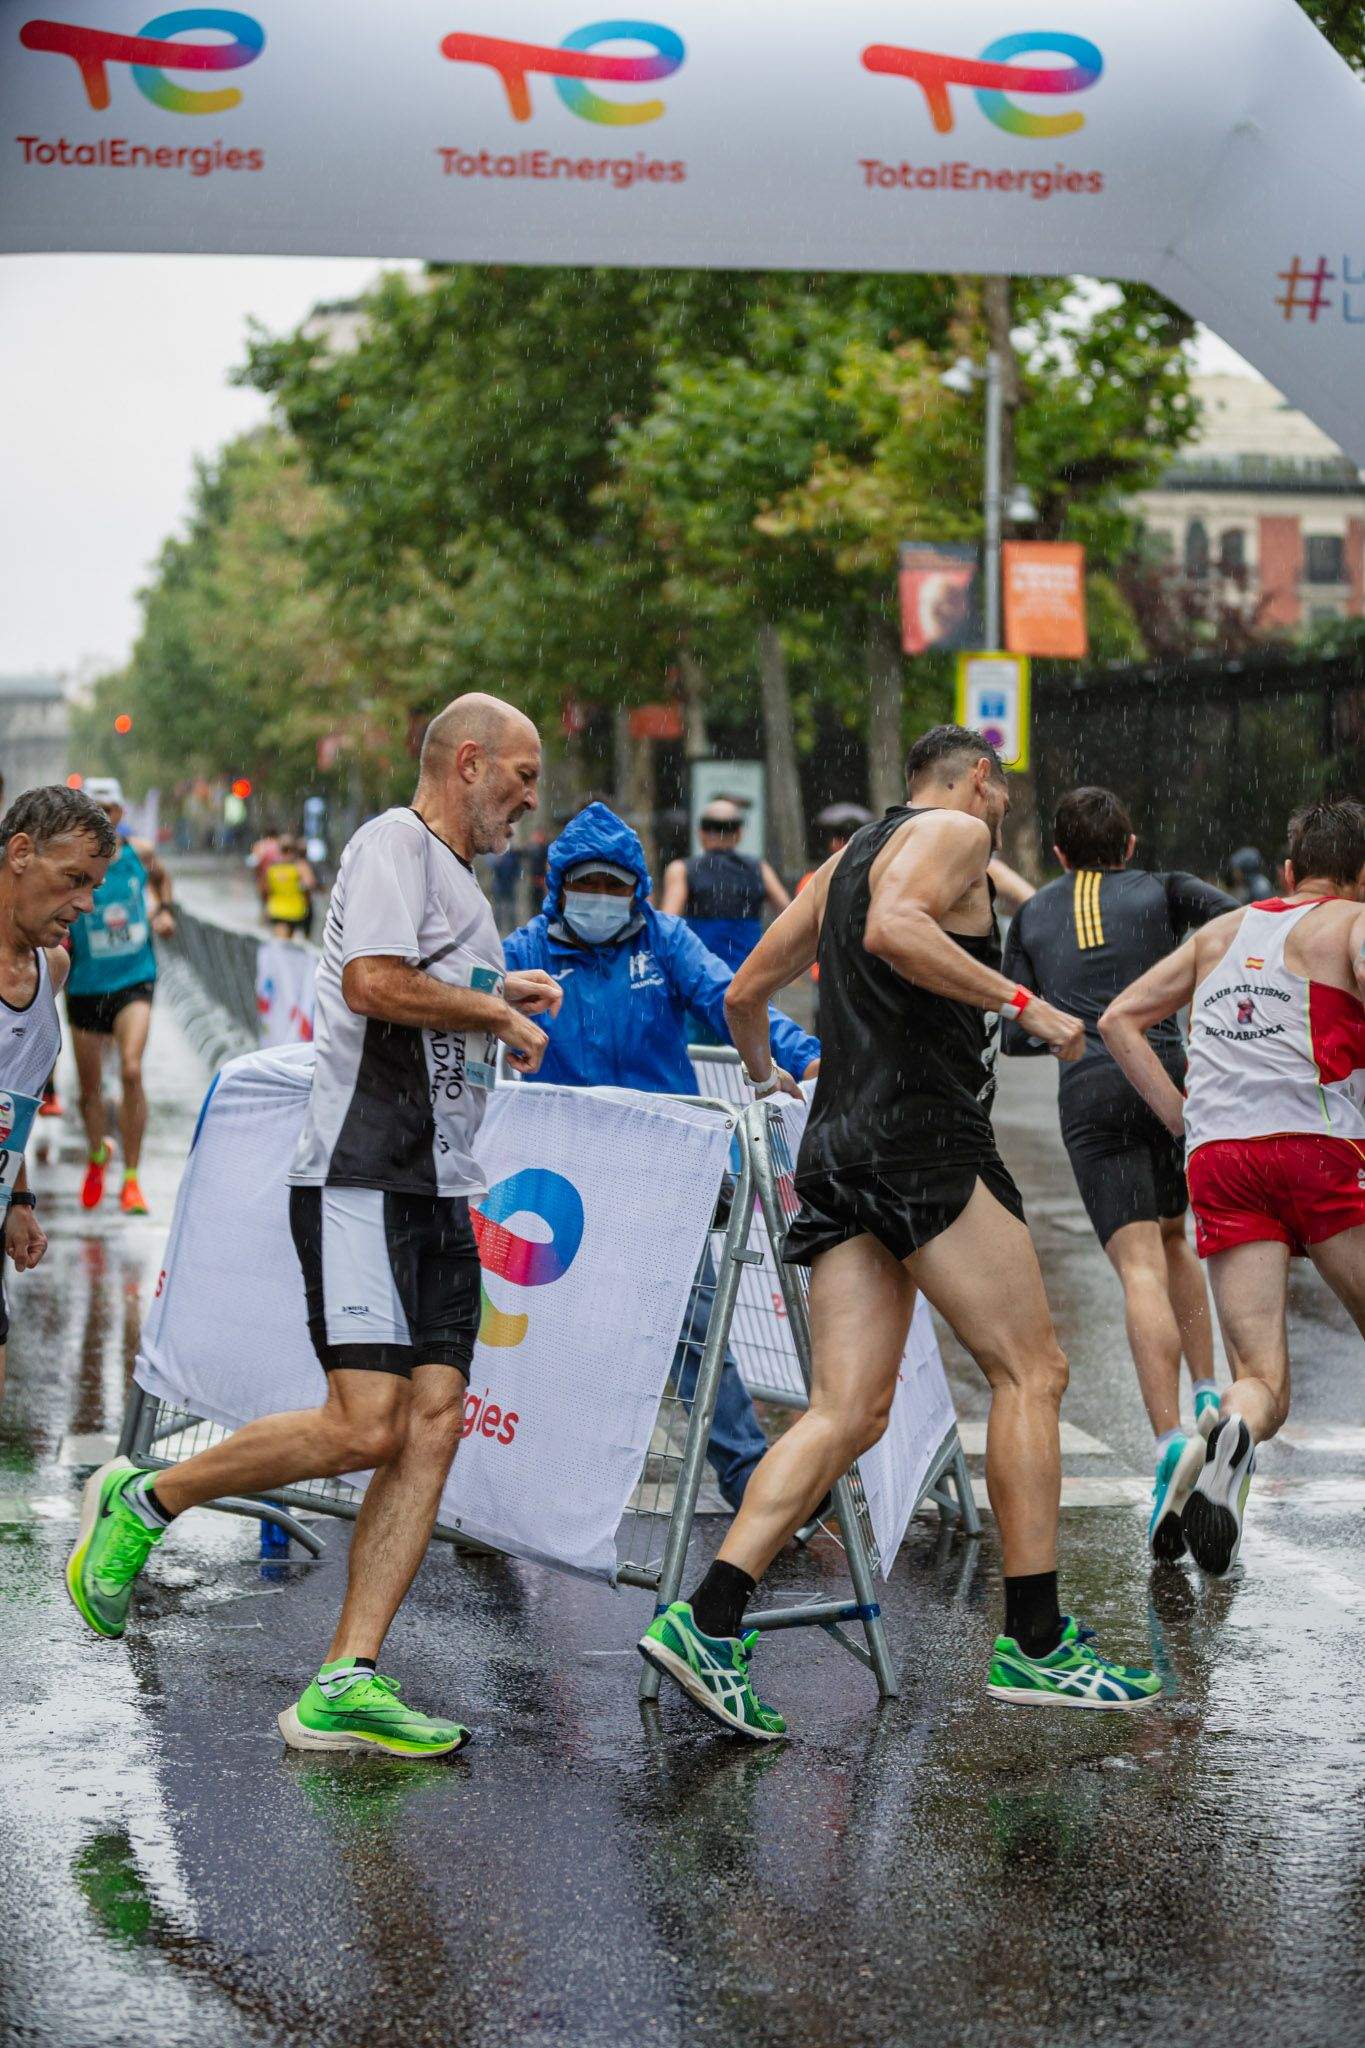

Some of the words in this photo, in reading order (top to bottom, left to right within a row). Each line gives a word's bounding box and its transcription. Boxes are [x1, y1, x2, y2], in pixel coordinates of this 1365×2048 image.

[17, 136, 264, 176] TotalEnergies
[439, 147, 686, 188] TotalEnergies
[860, 159, 1103, 199] TotalEnergies
[1203, 987, 1231, 1008] CLUB
[1233, 983, 1292, 1003] ATLETISMO
